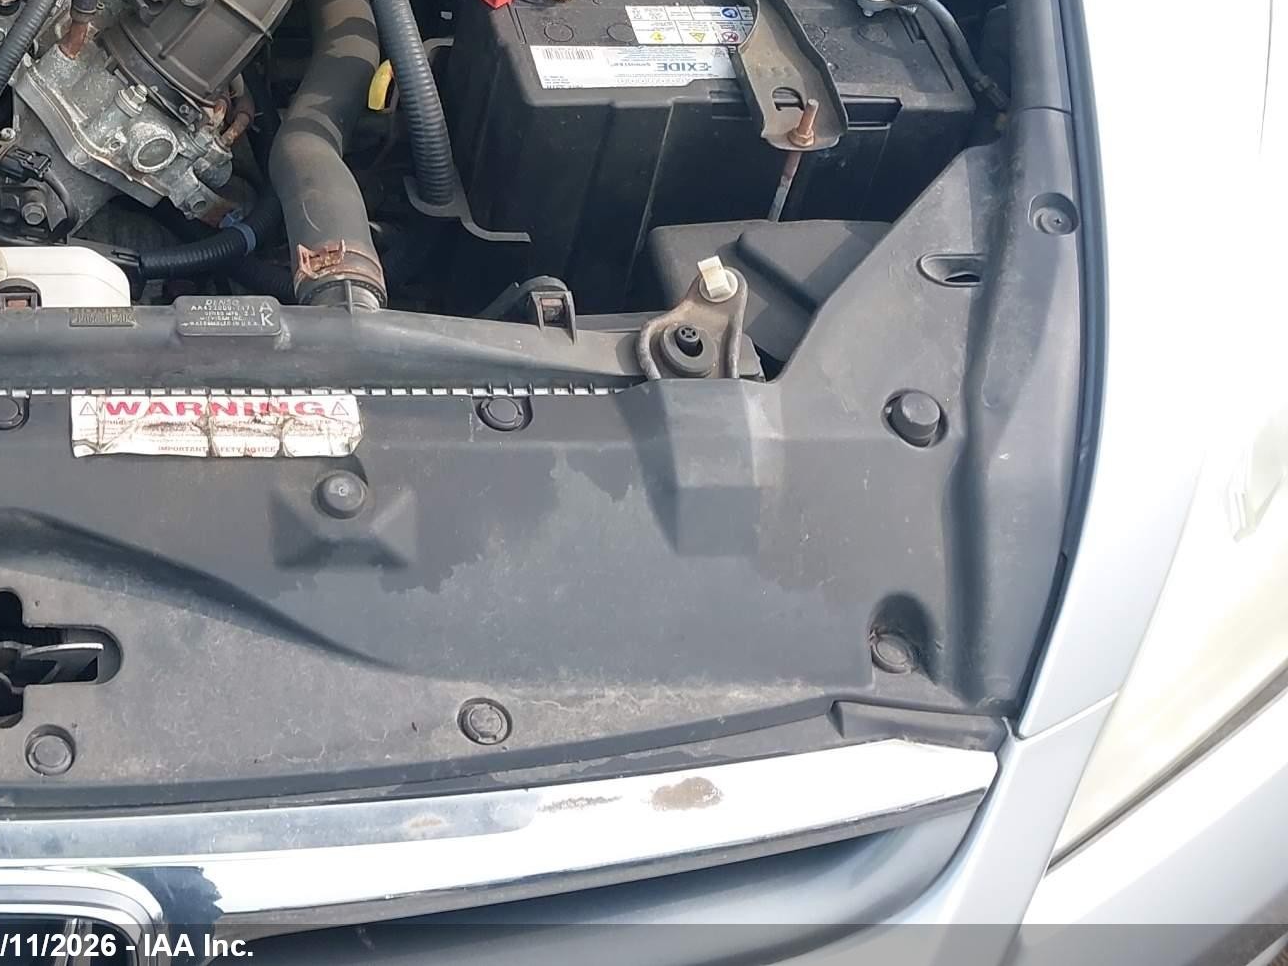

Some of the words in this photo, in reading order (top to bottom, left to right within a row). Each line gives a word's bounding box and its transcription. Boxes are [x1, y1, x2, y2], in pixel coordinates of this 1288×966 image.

[656, 62, 711, 72] EXIDE
[260, 312, 275, 327] K
[105, 401, 326, 416] WARNING
